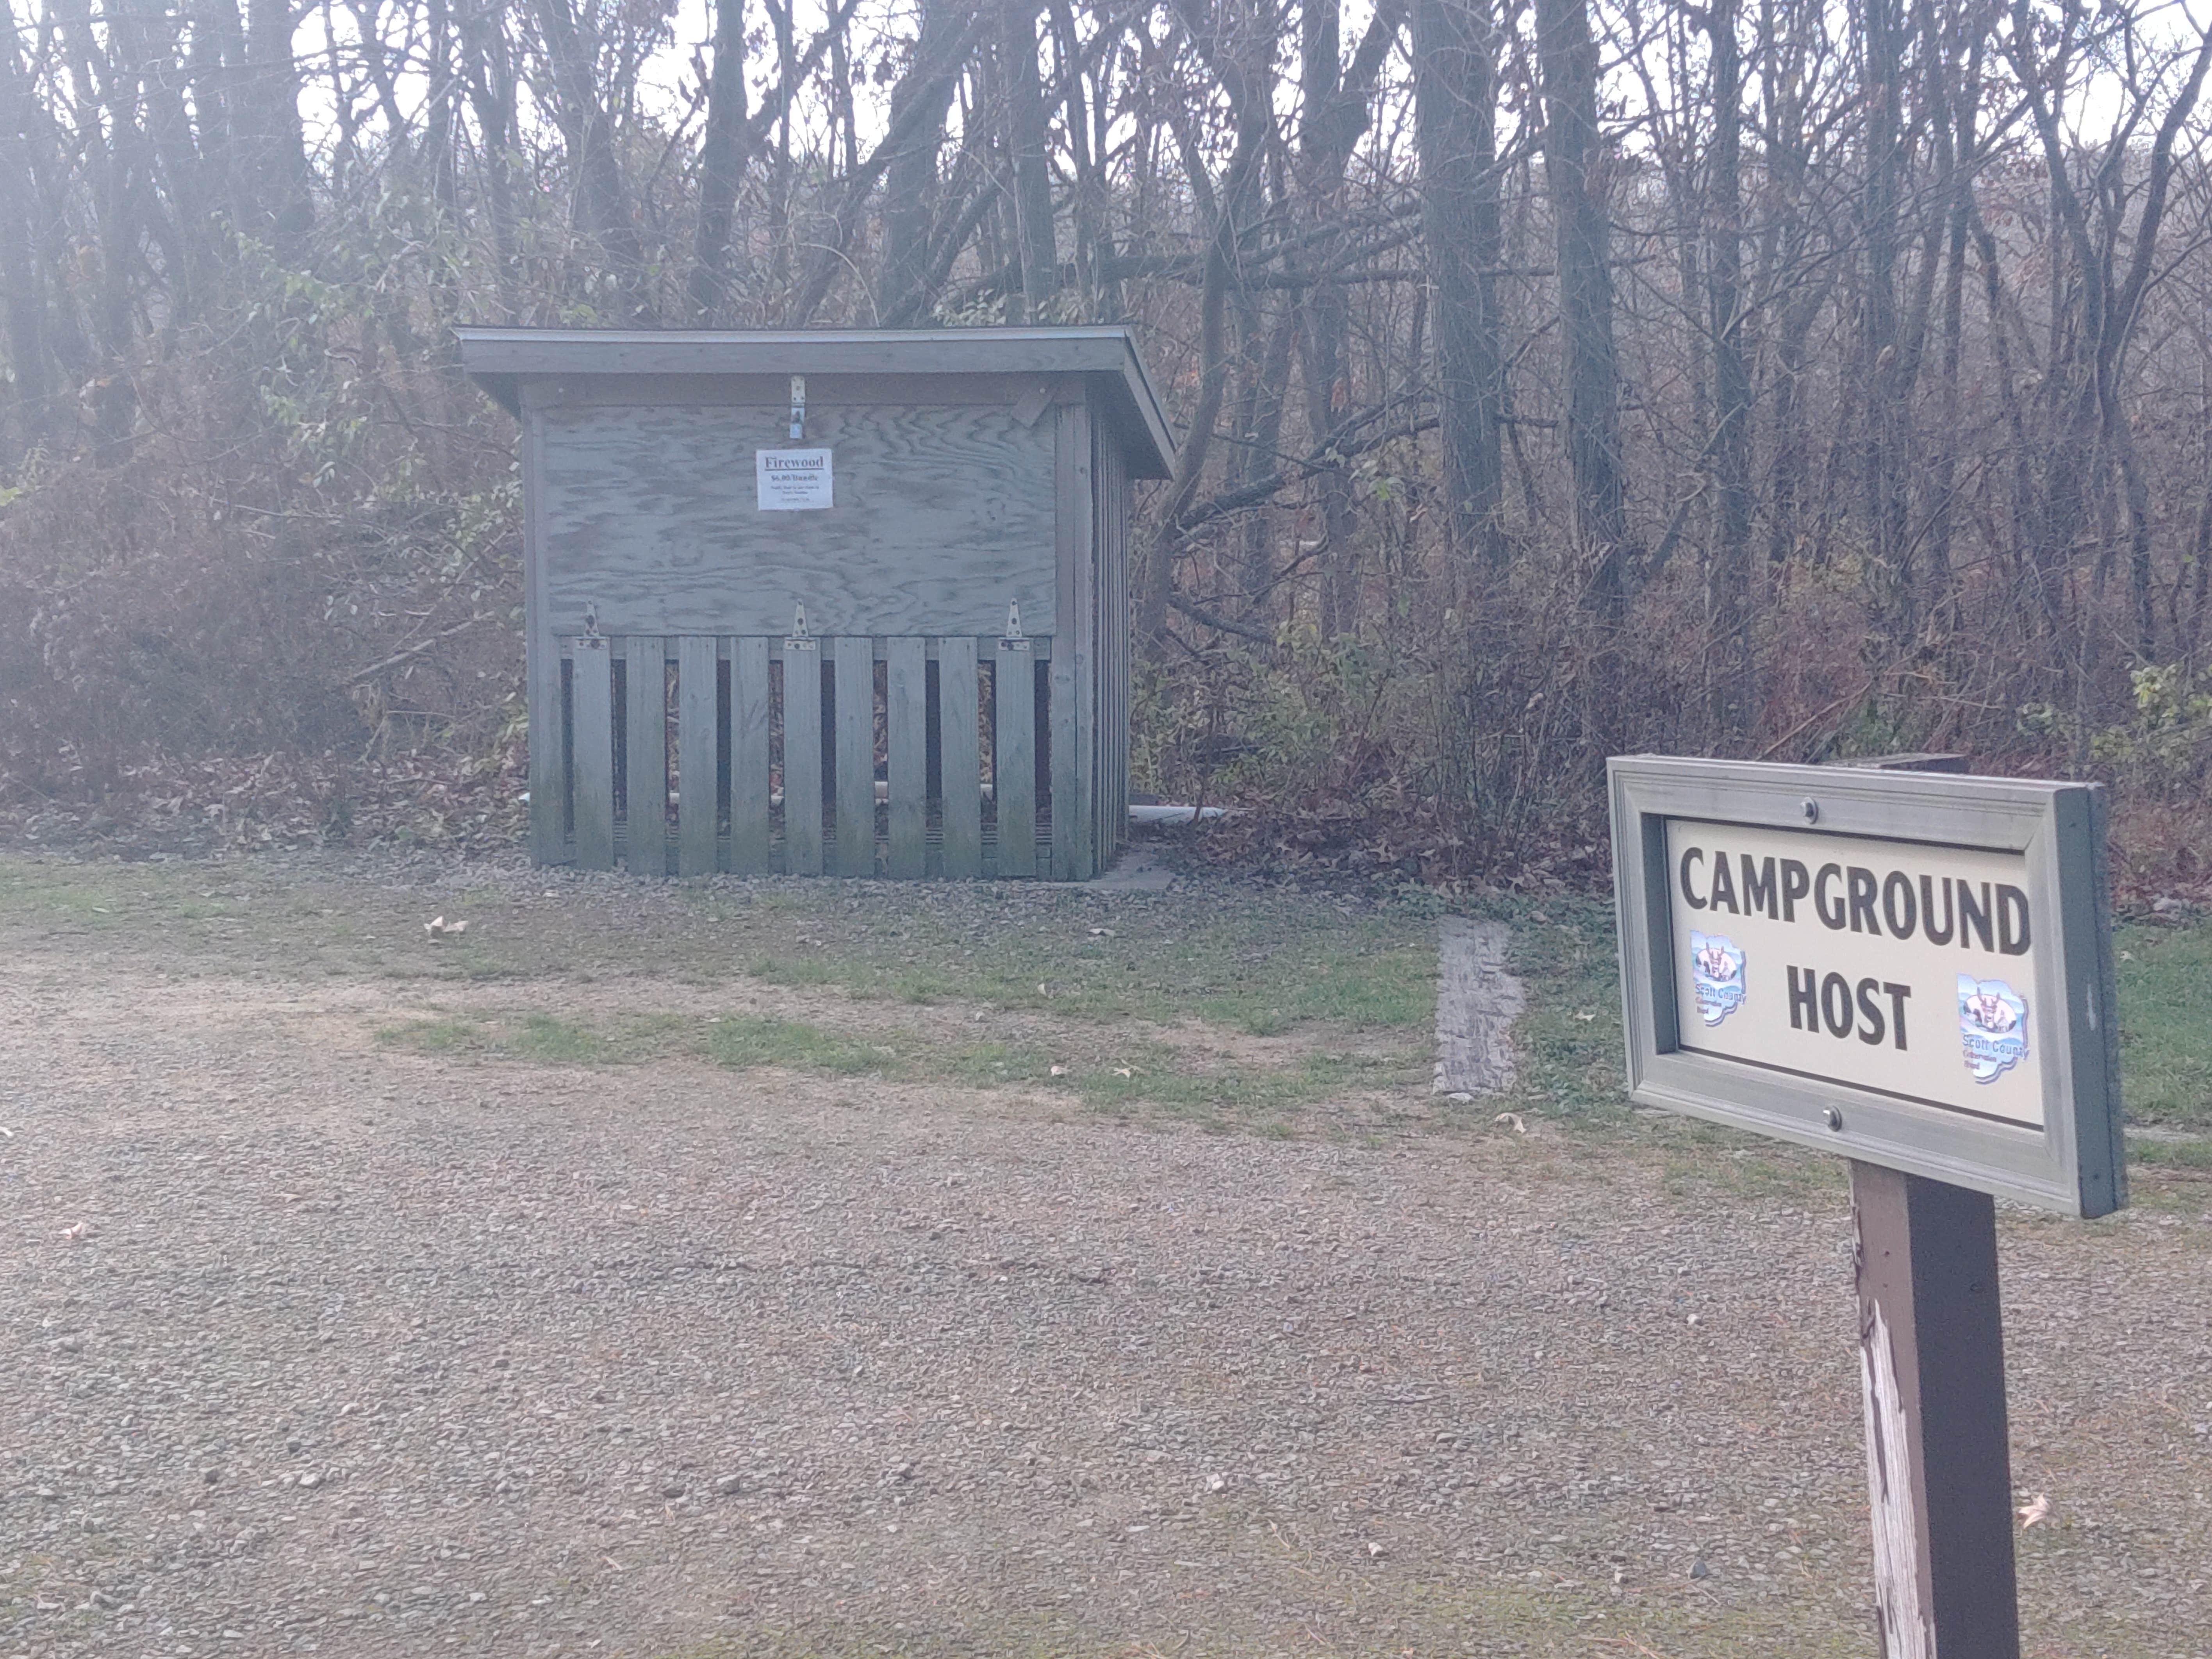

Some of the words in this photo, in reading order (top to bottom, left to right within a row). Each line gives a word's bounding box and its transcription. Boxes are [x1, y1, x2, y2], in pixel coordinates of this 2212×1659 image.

[765, 456, 823, 468] Firewood
[1680, 847, 2031, 956] CAMPGROUND
[1787, 965, 1911, 1051] HOST
[1963, 1035, 1989, 1050] Scott
[1993, 1040, 2030, 1060] County
